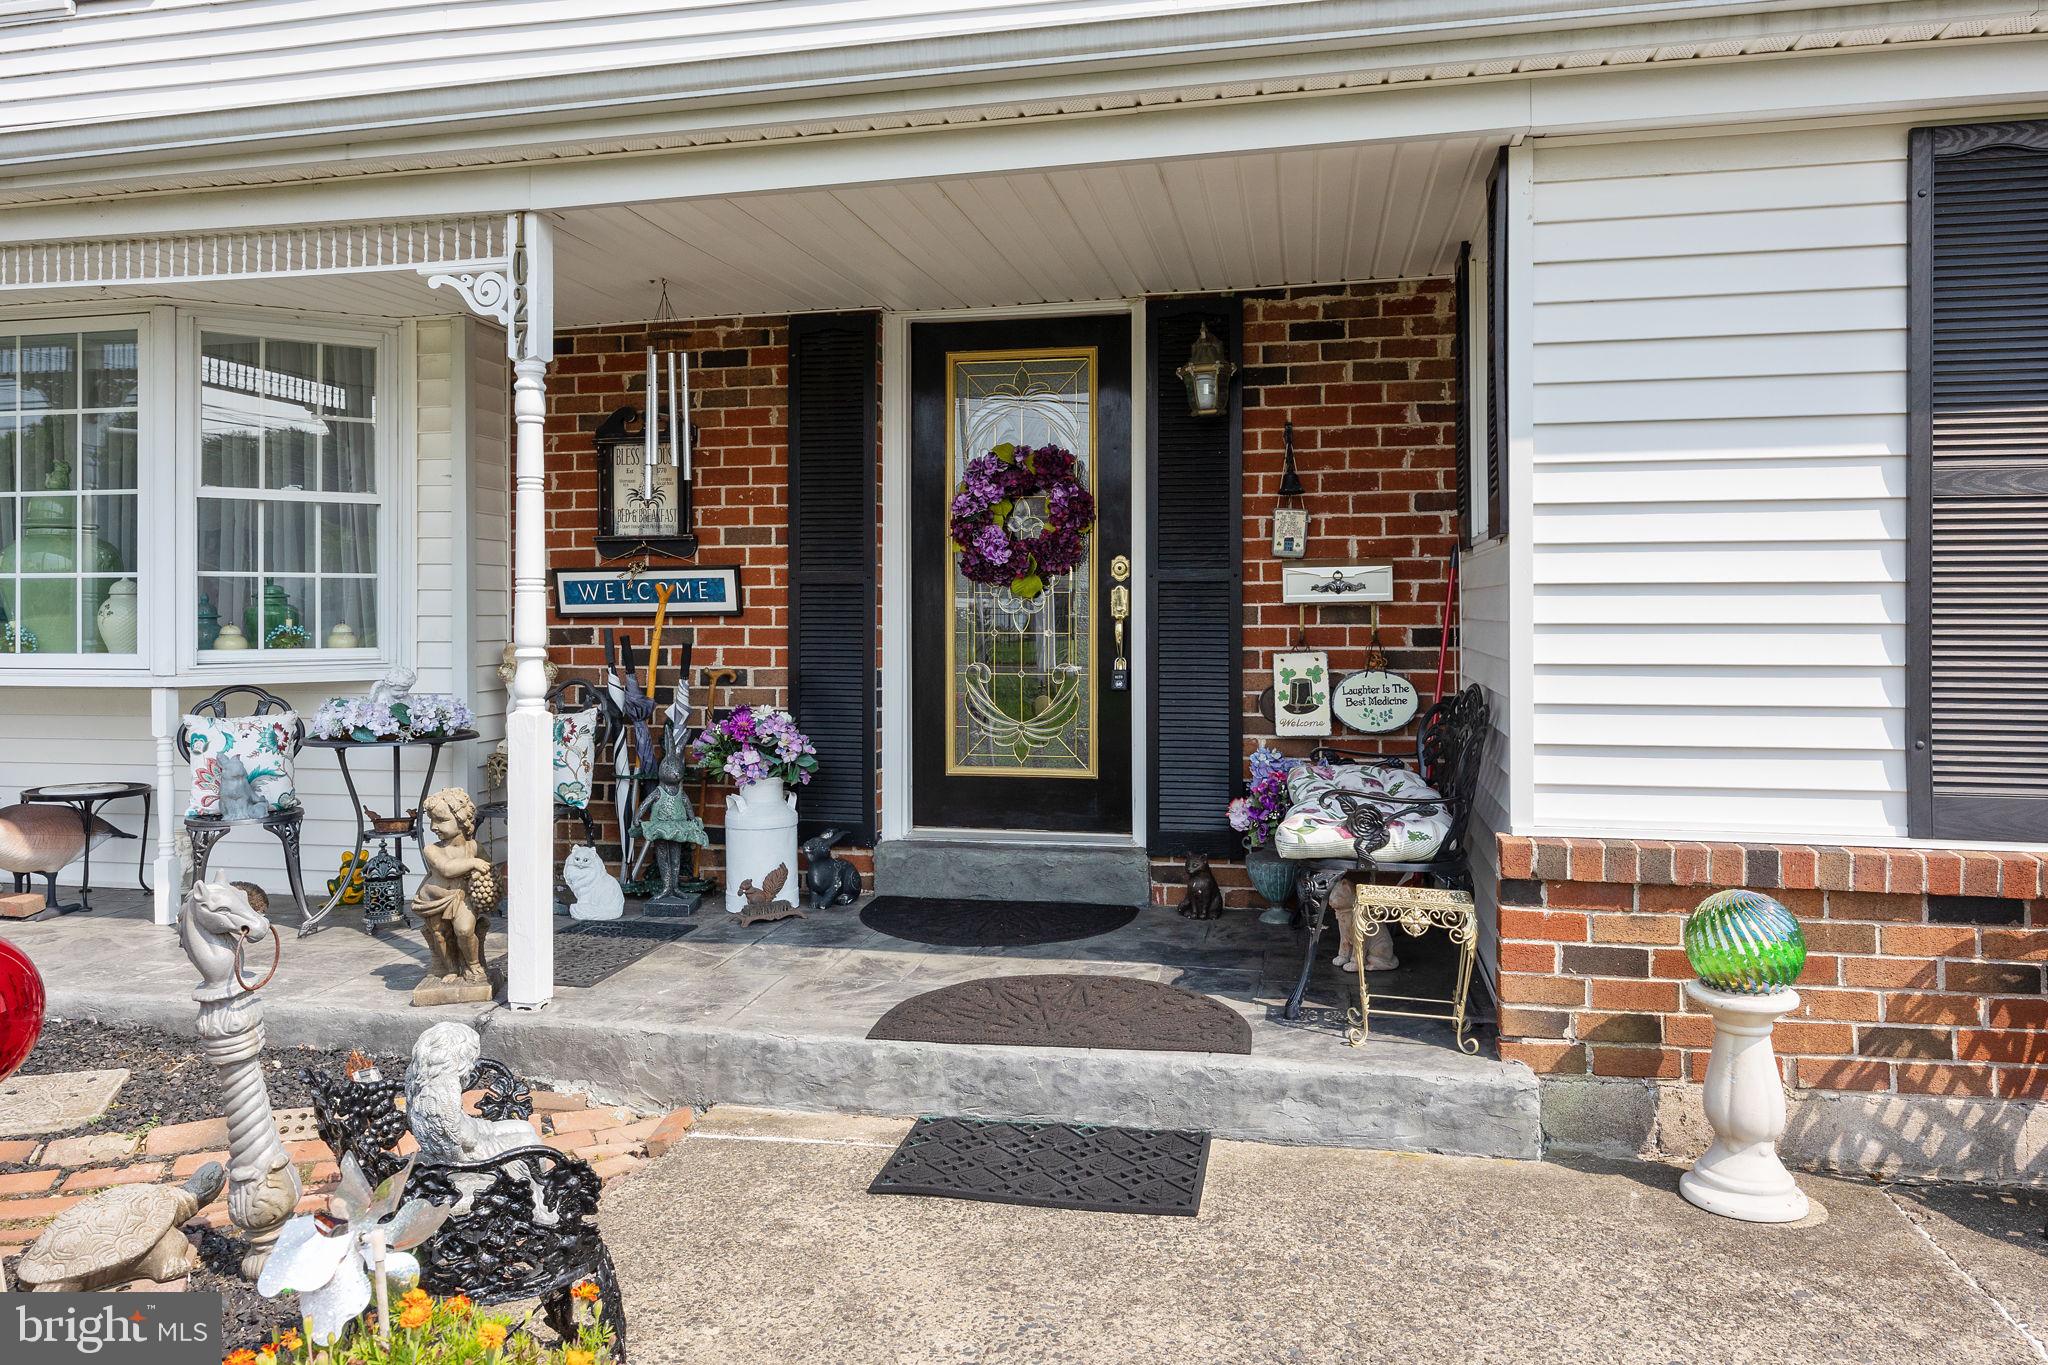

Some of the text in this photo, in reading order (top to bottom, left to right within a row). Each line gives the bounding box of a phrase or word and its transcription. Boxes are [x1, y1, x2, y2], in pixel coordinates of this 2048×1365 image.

[512, 211, 529, 361] 1027
[616, 447, 640, 466] BLESS
[1342, 683, 1410, 696] Laughter Is The
[1345, 696, 1408, 707] Best Medicine
[1279, 718, 1325, 727] Welcome
